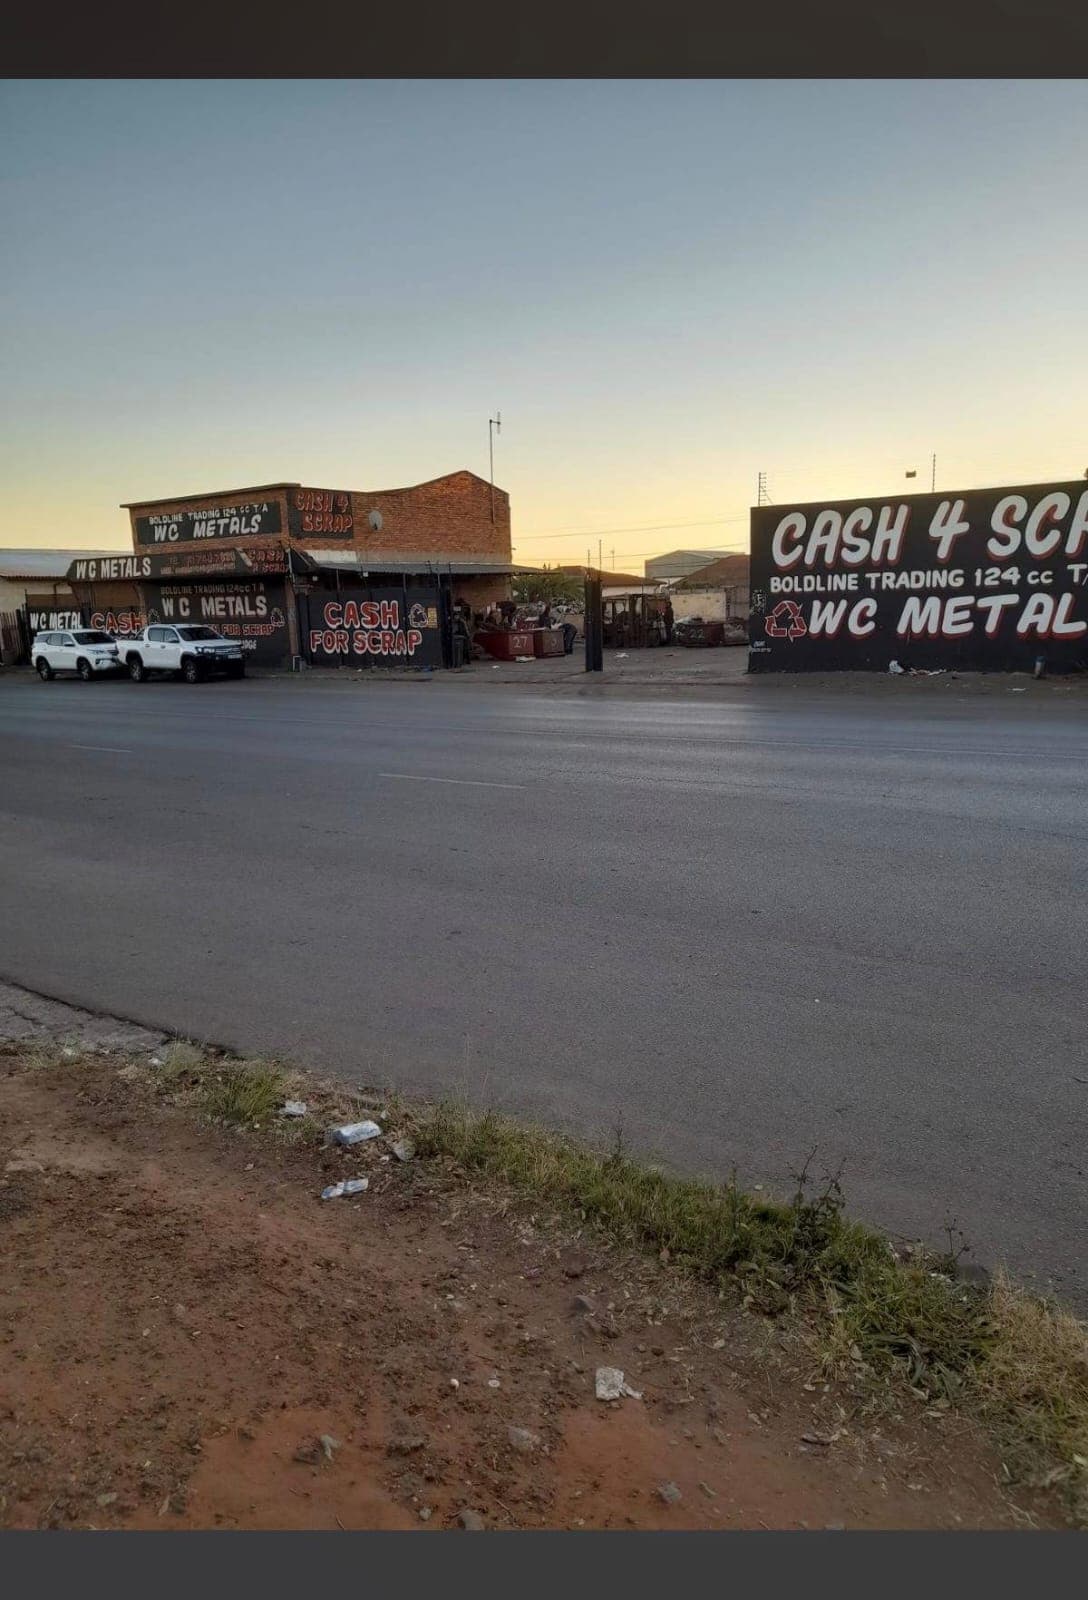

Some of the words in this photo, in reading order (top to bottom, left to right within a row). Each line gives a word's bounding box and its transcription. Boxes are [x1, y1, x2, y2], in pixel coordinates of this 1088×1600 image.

[295, 491, 334, 512] CASH
[335, 494, 349, 513] 4
[149, 513, 183, 525] BOLDLINE
[188, 509, 220, 521] TRADING
[223, 507, 236, 518] 124
[302, 512, 353, 533] SCRAP
[154, 524, 179, 542] WC
[193, 514, 262, 538] METALS
[770, 503, 909, 570] CASH
[928, 499, 970, 563] 4
[76, 559, 97, 579] WC
[100, 556, 152, 579] METALS
[194, 584, 224, 594] TRADING
[770, 572, 859, 594] BOLDLINE
[865, 569, 965, 591] TRADING
[974, 566, 1022, 587] 124
[161, 597, 191, 617] WC
[200, 595, 268, 617] METALS
[323, 600, 400, 630] CASH
[808, 596, 878, 639] WC
[896, 591, 1088, 641] METAL
[30, 612, 47, 630] WC
[49, 611, 83, 630] METAL
[90, 611, 147, 635] CASH
[223, 623, 241, 635] FOR
[242, 623, 275, 636] SCRAP
[310, 630, 349, 654] FOR
[353, 629, 423, 656] SCRAP
[512, 635, 528, 648] 27
